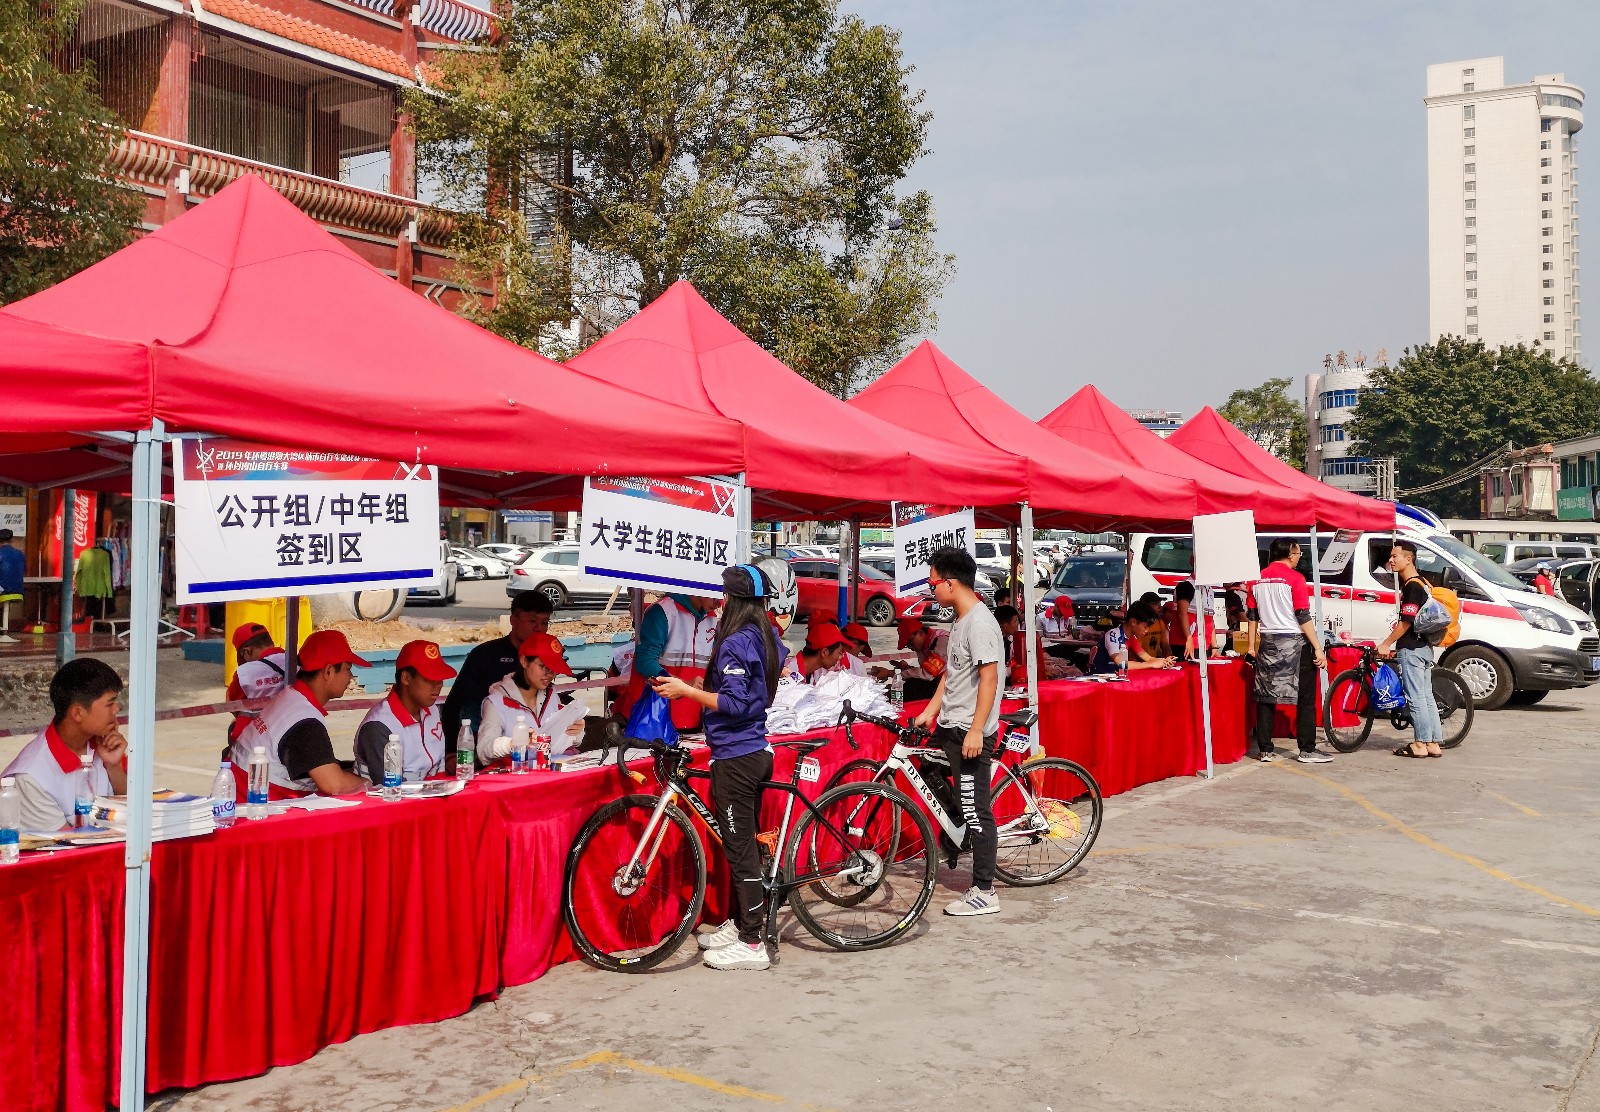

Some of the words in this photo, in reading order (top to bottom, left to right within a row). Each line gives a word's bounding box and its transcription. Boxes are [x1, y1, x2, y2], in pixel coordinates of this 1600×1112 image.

[216, 491, 409, 529] 公开组/中年组
[276, 531, 363, 567] 签到区
[590, 517, 729, 567] 大学生组签到区
[803, 766, 816, 776] 011
[907, 765, 921, 784] DE
[920, 784, 943, 816] ROSA
[960, 773, 983, 833] ANTARCTIC
